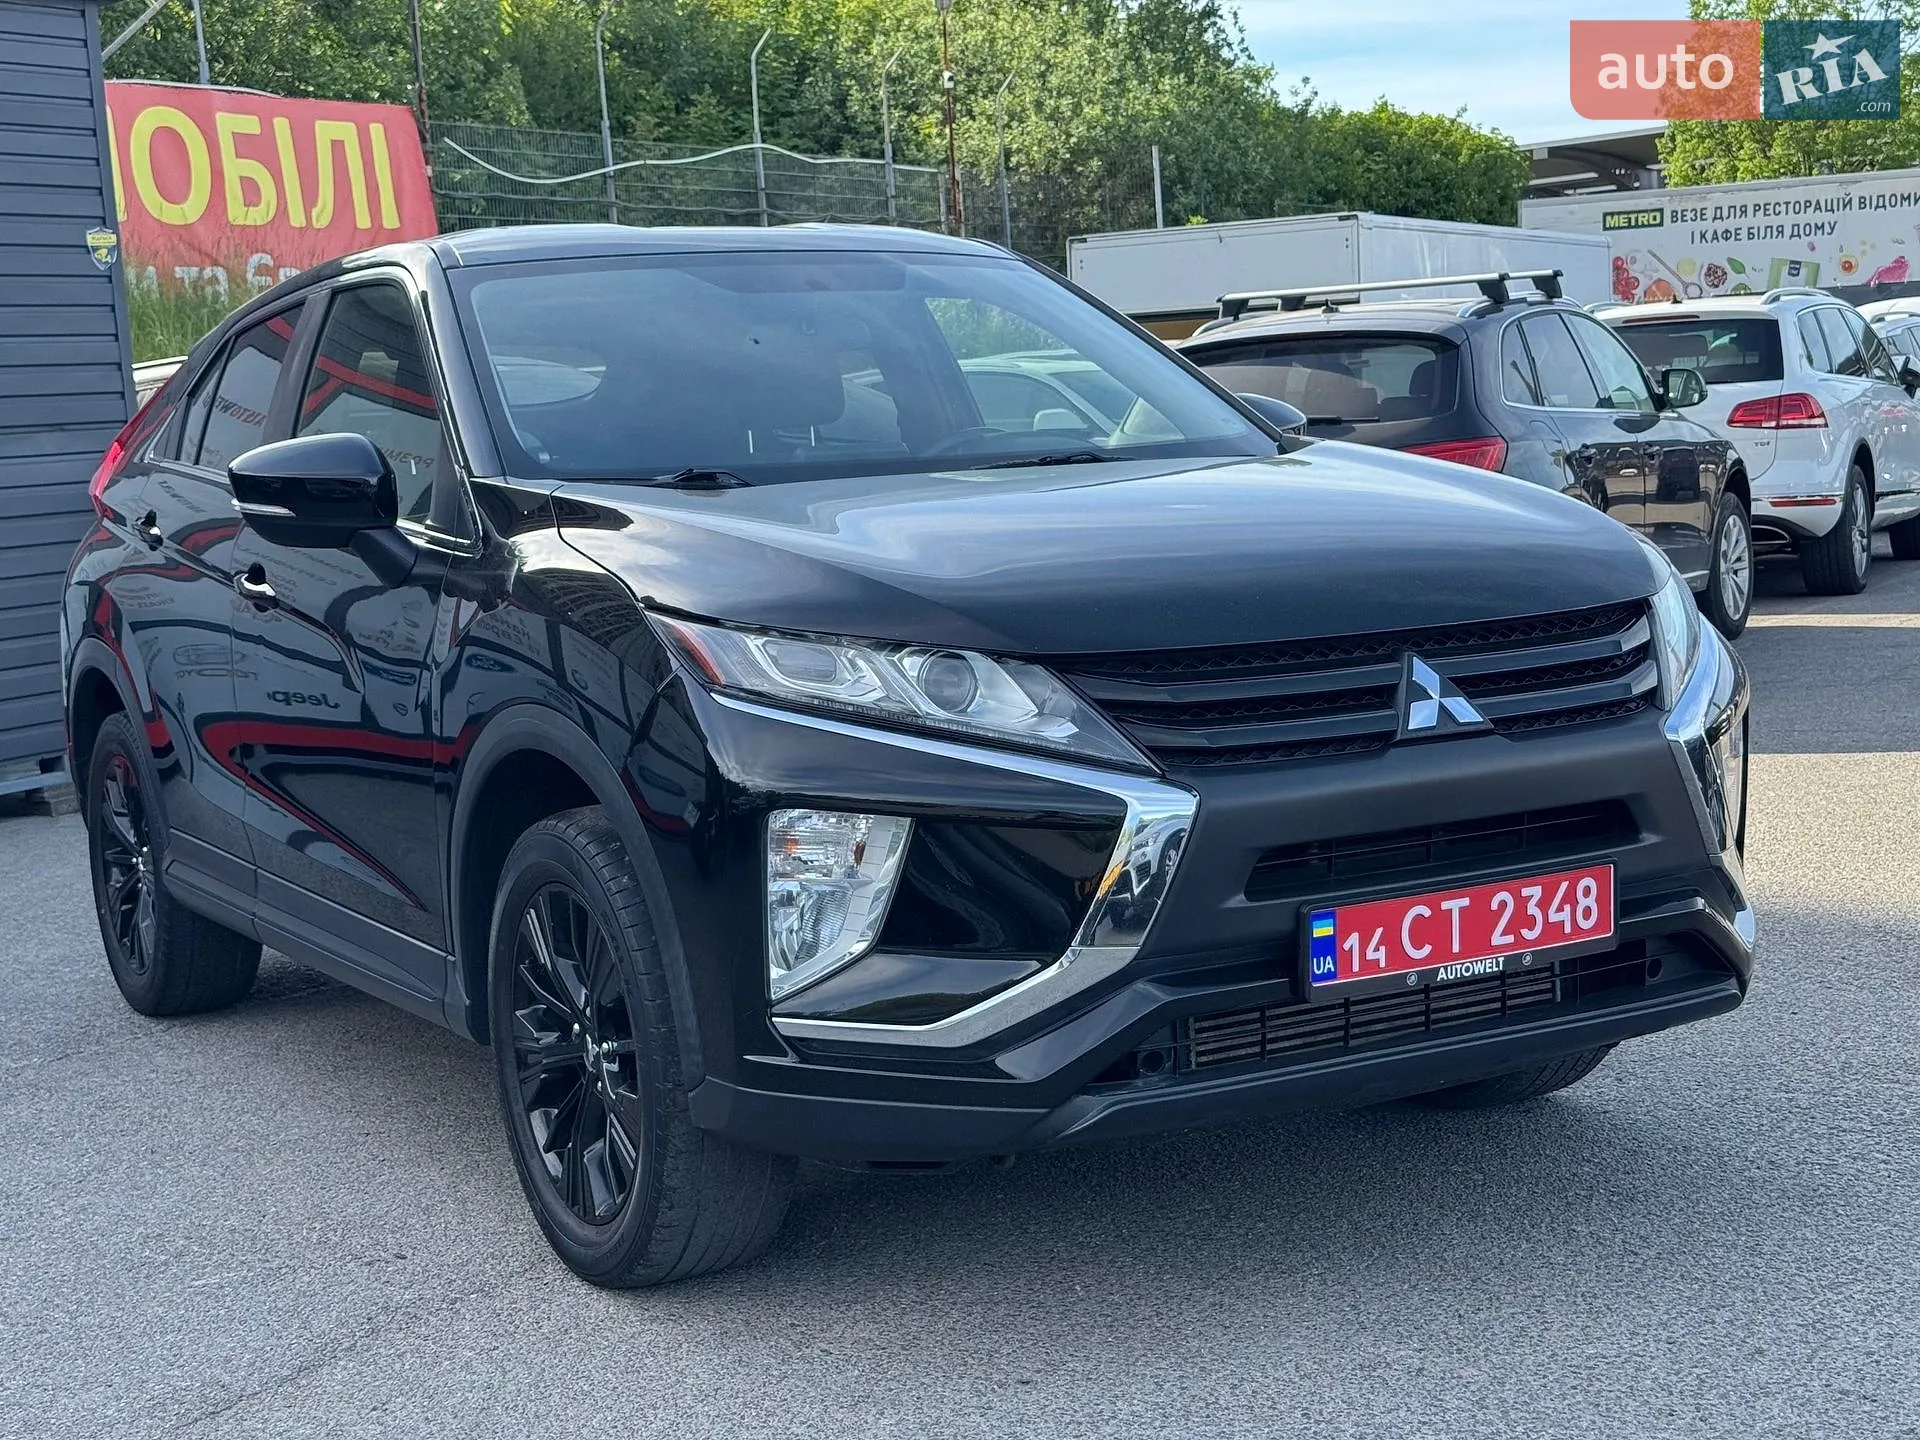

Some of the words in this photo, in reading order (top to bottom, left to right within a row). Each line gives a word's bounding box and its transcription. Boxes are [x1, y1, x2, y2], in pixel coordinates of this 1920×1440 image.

[1605, 211, 1661, 228] METRO
[1670, 207, 1708, 224] ВЕЗЕ
[1712, 204, 1748, 223] ДЛЯ
[1753, 192, 1853, 218] РЕСТОРАЦІЙ
[1699, 227, 1742, 244] КАФЕ
[1747, 224, 1784, 241] БІЛЯ
[1789, 220, 1839, 241] ДОМУ
[1343, 926, 1386, 973] 14
[1401, 896, 1470, 959] CT
[1490, 877, 1598, 946] 2348
[1313, 956, 1335, 975] UA
[1437, 957, 1505, 982] AUTOWELT
